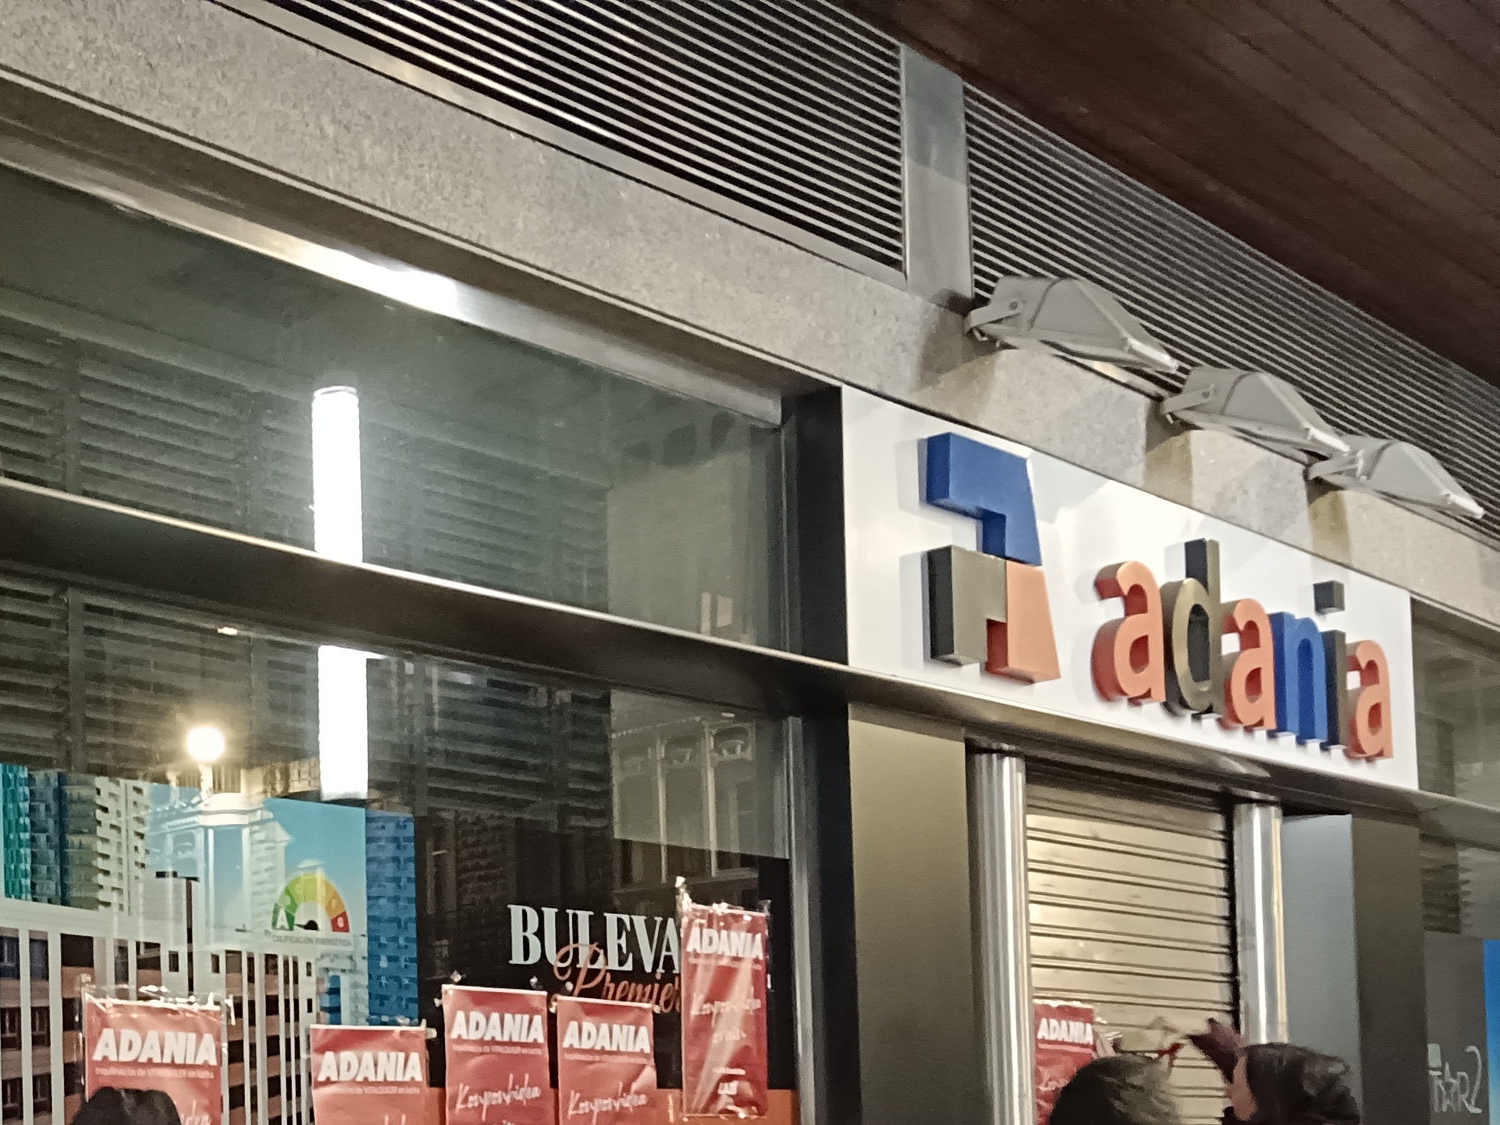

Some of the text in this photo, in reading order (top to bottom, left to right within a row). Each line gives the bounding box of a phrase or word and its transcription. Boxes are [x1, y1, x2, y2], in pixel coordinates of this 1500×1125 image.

[1092, 538, 1394, 764] adania
[507, 904, 681, 974] BULEVA
[687, 927, 764, 960] ADANIA
[551, 942, 681, 1013] Premie
[450, 1010, 545, 1043] ADANIA
[563, 1020, 651, 1053] ADANIA
[1037, 1017, 1094, 1046] ADANIA
[92, 1028, 218, 1066] ADANIA
[317, 1051, 423, 1082] ADANIA
